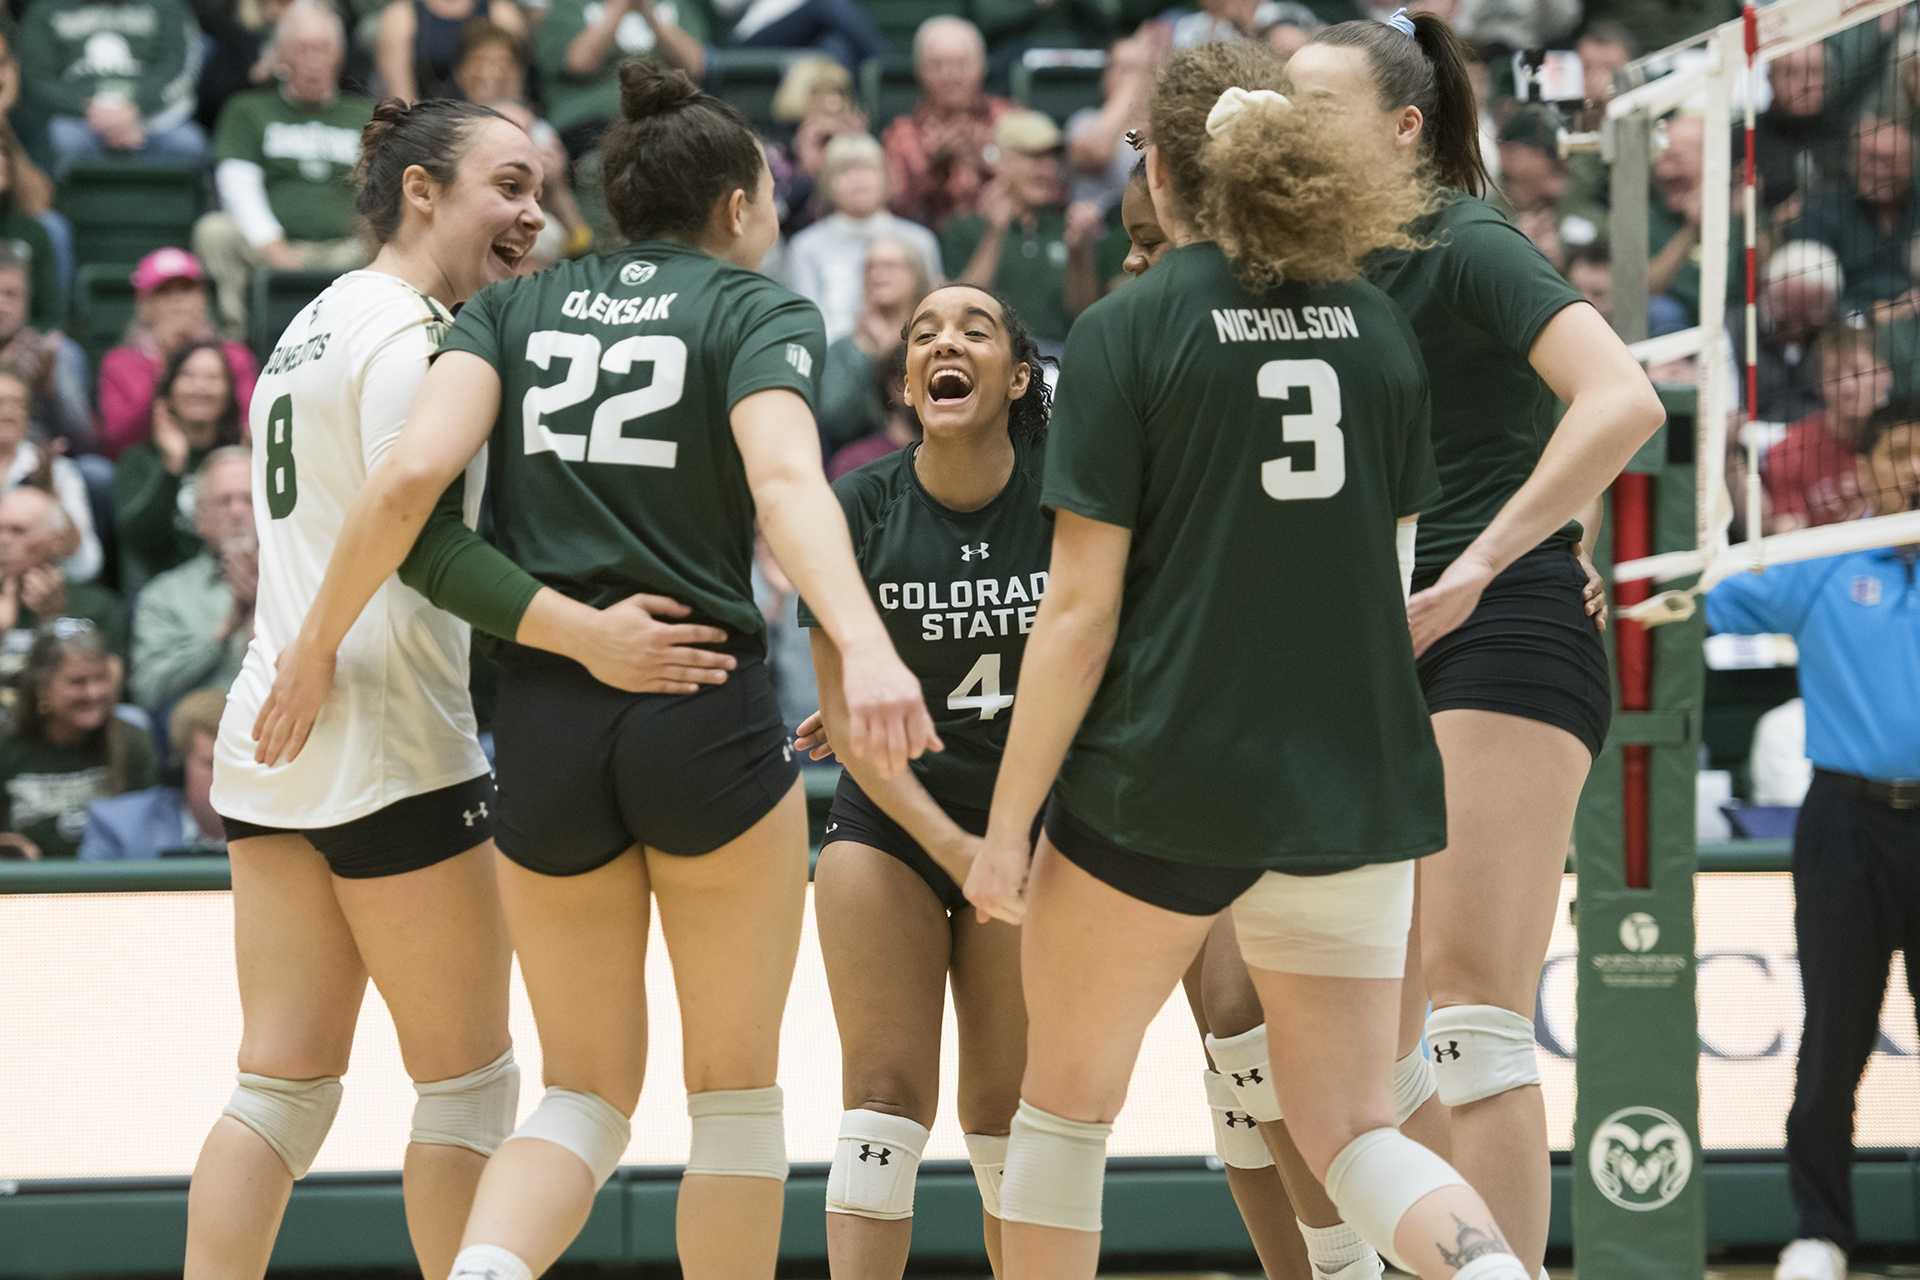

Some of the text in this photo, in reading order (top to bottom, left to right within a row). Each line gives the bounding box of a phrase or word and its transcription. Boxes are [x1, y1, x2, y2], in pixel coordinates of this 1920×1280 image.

[561, 289, 679, 325] OLEKSAK
[1211, 306, 1359, 343] NICHOLSON
[522, 330, 688, 469] 22
[266, 393, 298, 520] 8
[1256, 358, 1346, 501] 3
[878, 570, 1050, 610] COLORAD
[921, 605, 1037, 641] STATE
[946, 653, 1015, 721] 4
